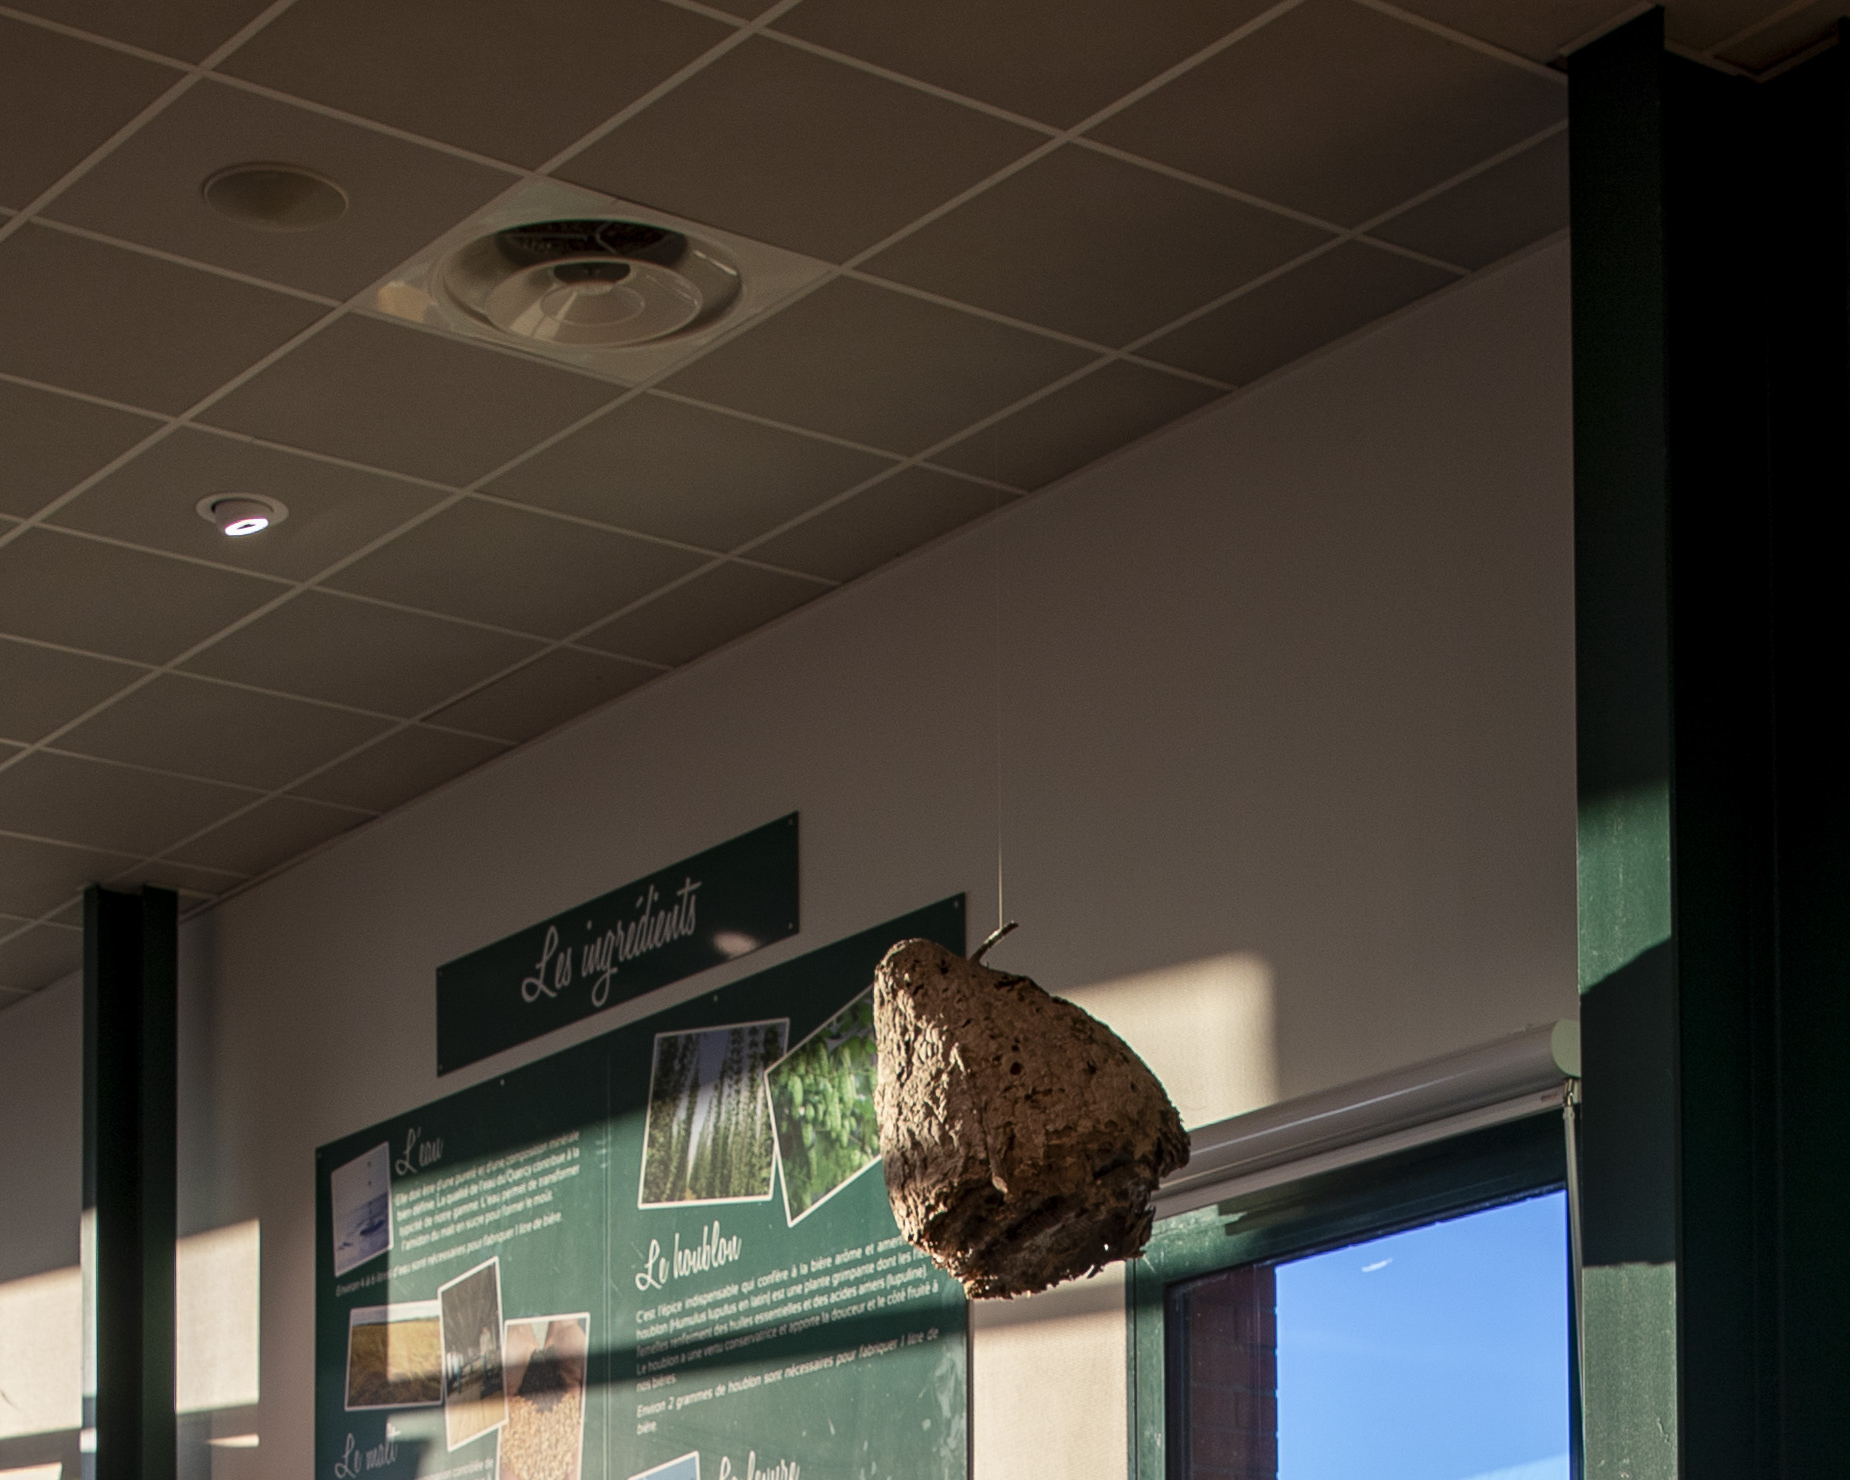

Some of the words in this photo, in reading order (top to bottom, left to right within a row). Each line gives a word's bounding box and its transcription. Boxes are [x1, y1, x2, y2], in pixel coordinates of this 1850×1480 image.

[521, 924, 572, 1003] Les
[581, 877, 702, 1007] ingrédients
[635, 1238, 668, 1290] Le
[673, 1220, 742, 1279] houblon
